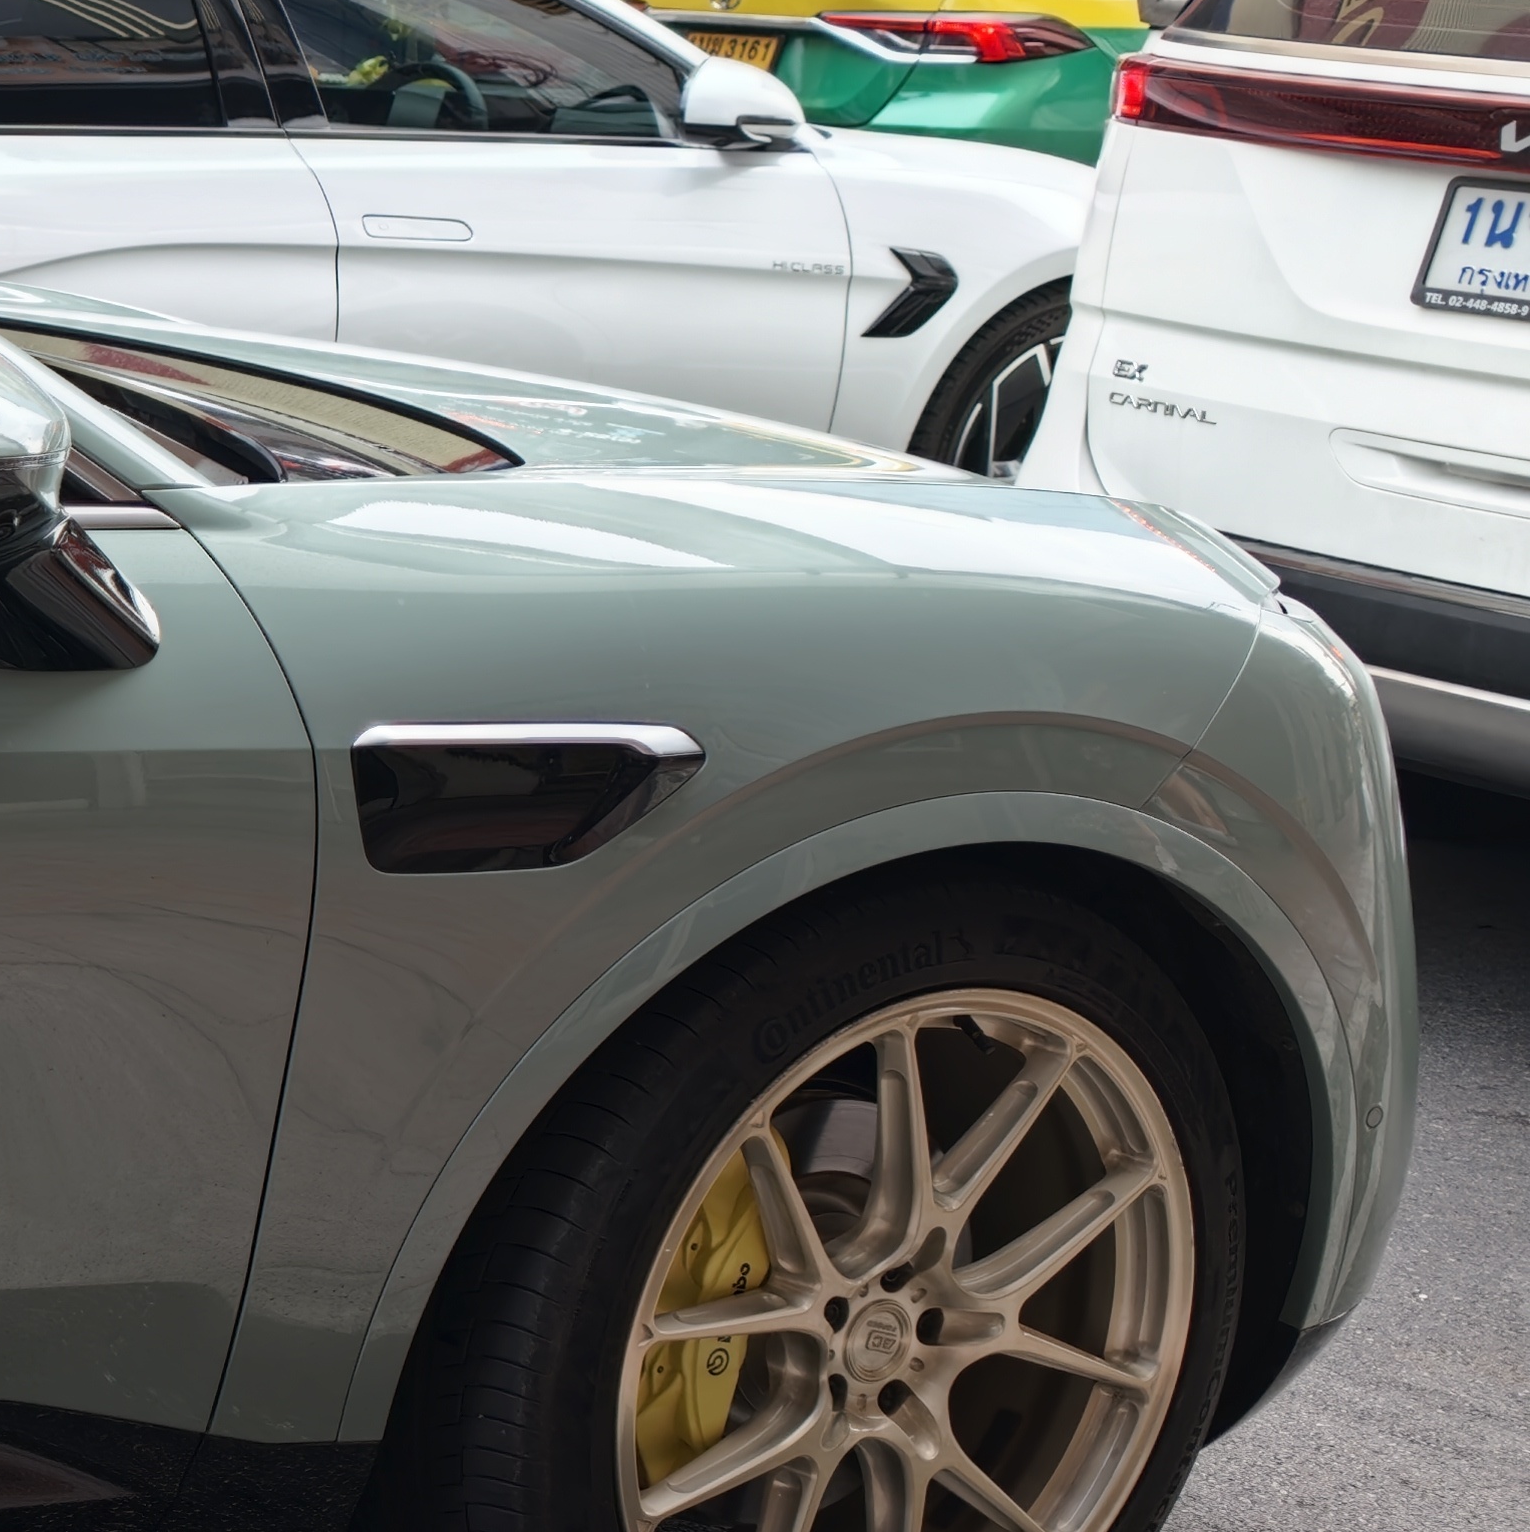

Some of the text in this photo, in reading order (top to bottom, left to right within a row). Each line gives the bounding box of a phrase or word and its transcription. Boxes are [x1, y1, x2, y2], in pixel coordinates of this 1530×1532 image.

[725, 37, 772, 61] 3161
[1461, 197, 1530, 249] 1น
[1113, 359, 1148, 382] EX
[1109, 392, 1217, 425] CARNIVAL
